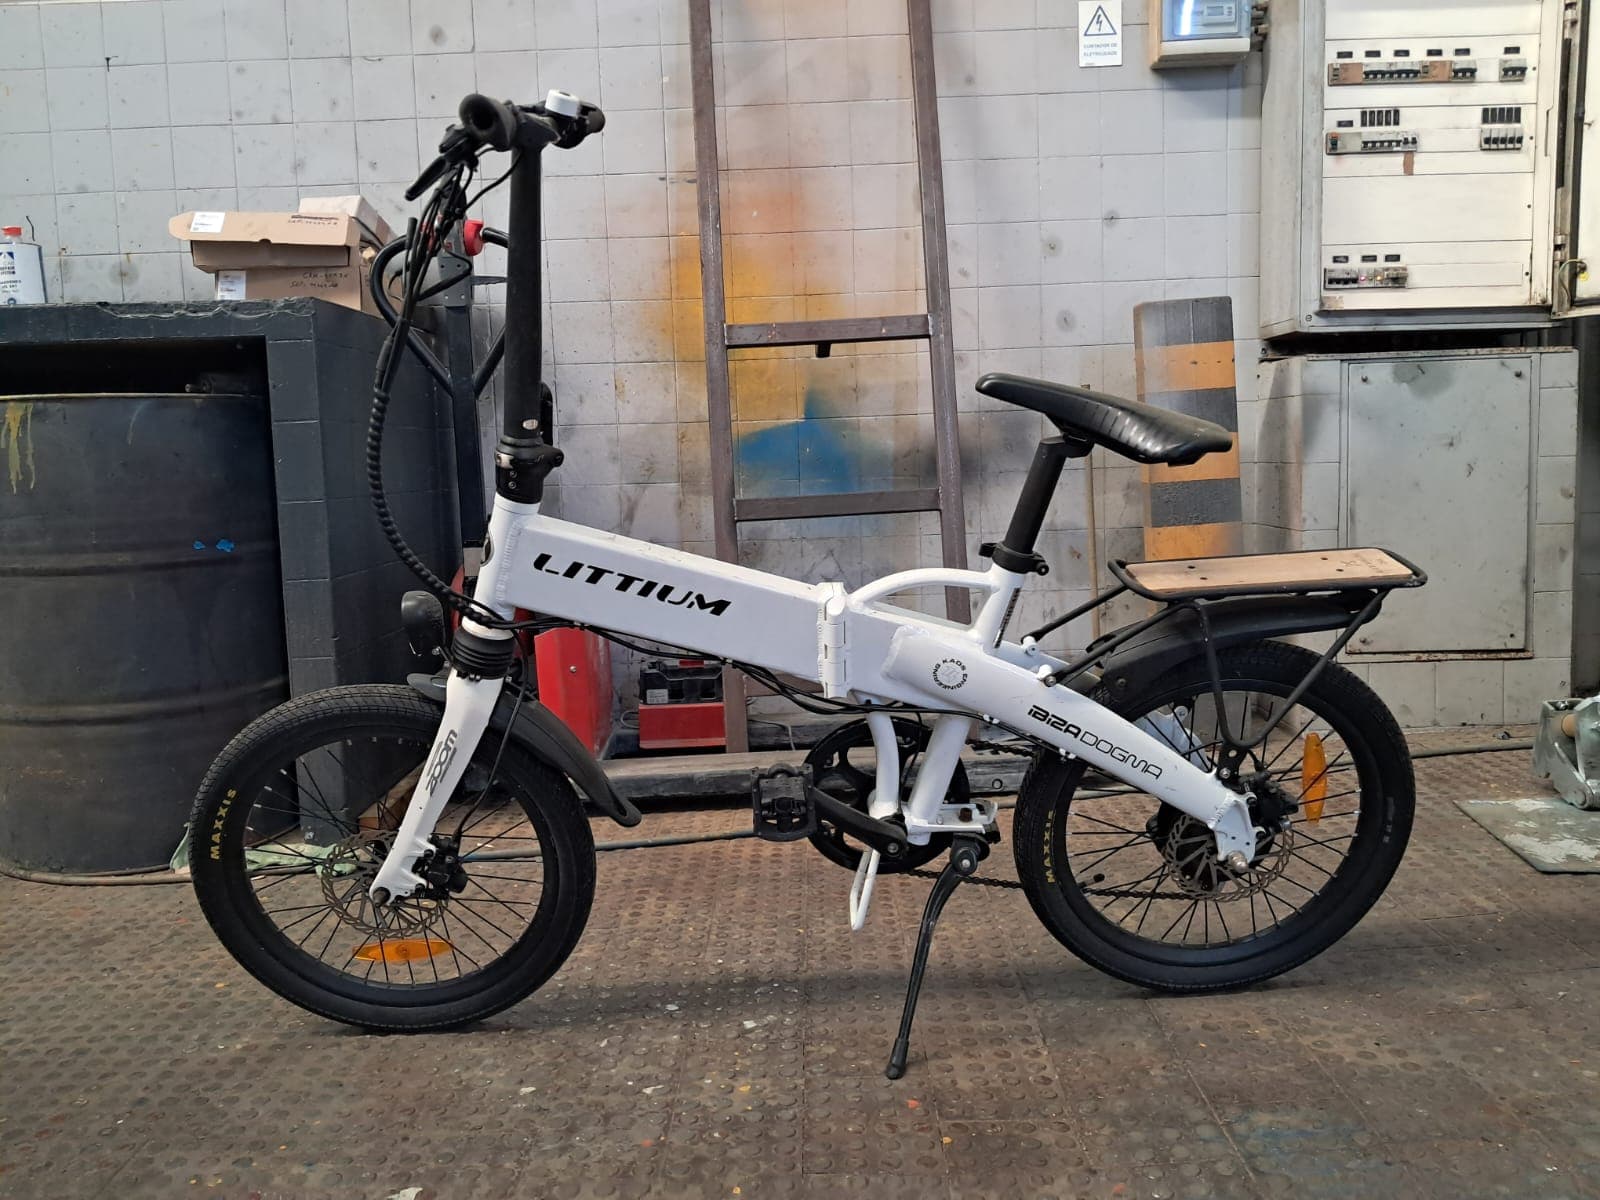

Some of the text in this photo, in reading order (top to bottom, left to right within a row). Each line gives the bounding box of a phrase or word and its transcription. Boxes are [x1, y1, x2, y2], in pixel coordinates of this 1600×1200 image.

[533, 553, 732, 616] LITTIUM
[932, 658, 968, 690] KAOS ENGINEERING
[1079, 730, 1163, 780] DOGMA
[210, 788, 238, 860] MAXXIS
